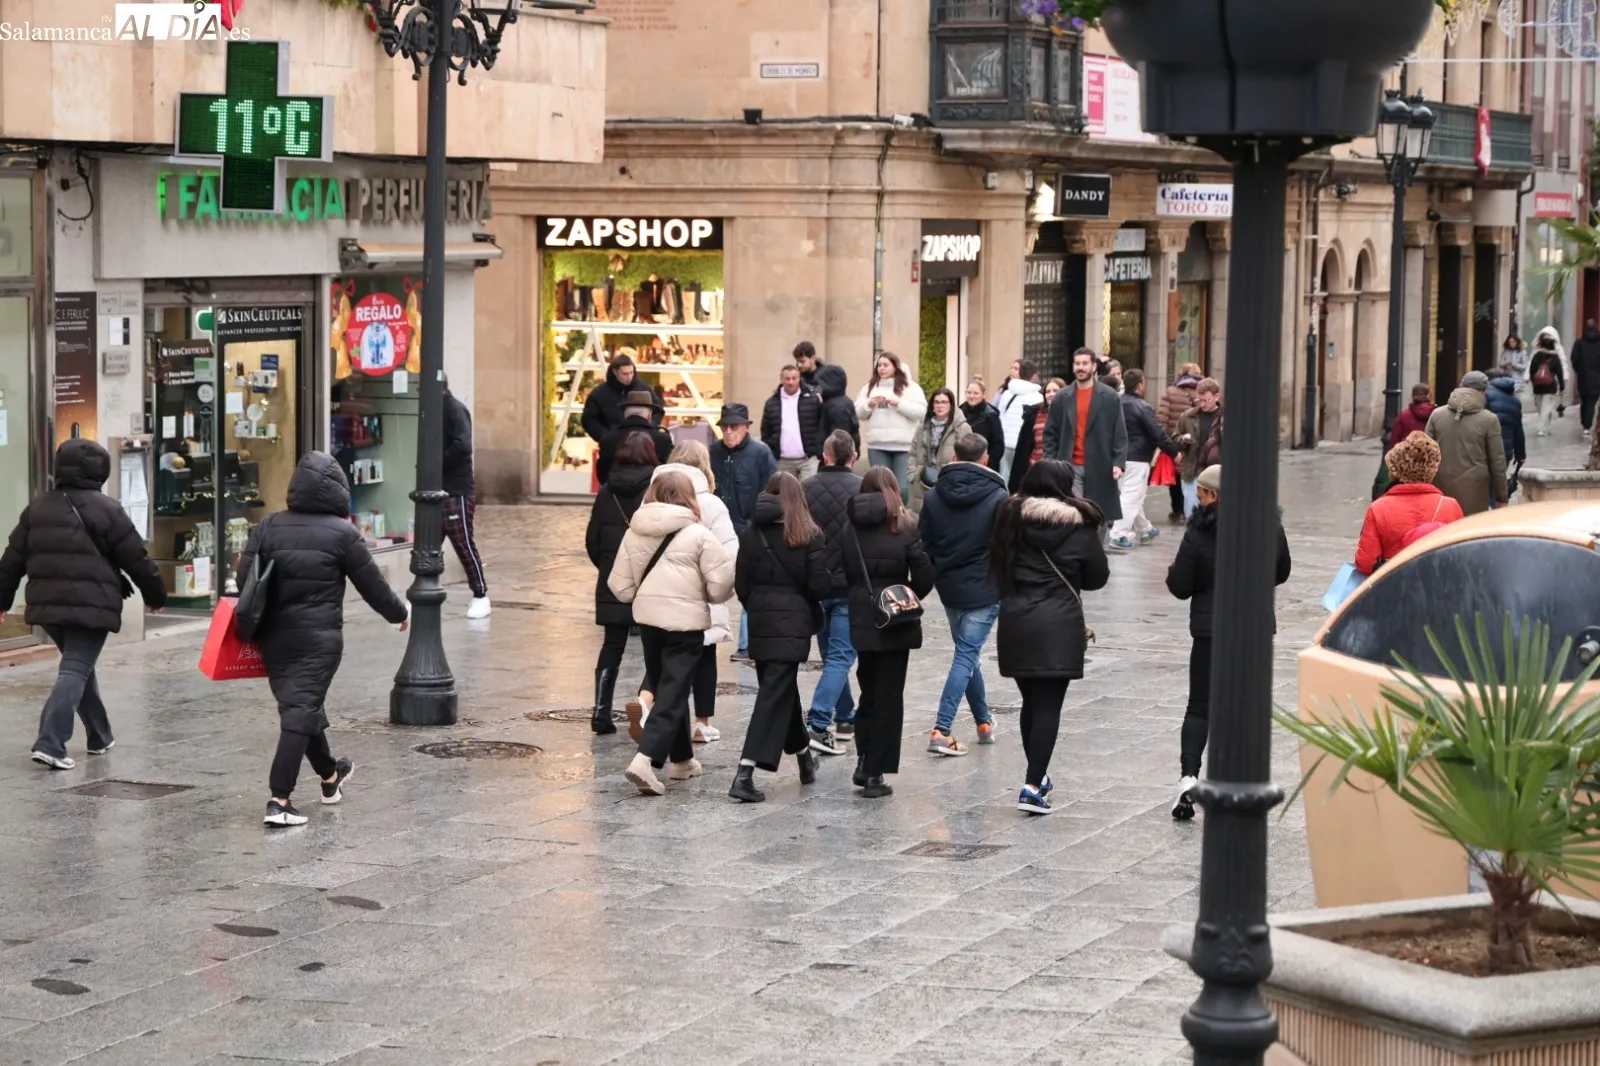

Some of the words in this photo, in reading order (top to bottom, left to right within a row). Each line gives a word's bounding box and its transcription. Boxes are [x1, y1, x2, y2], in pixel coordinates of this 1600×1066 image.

[179, 176, 345, 221] FACIA
[359, 177, 492, 221] PERFUERIA
[1065, 189, 1105, 201] DANDY
[1164, 201, 1208, 213] TORO
[1214, 204, 1229, 214] 70
[545, 218, 713, 248] ZAPSHOP
[922, 235, 981, 262] ZAPSHOP
[1024, 260, 1065, 285] DANDY
[1104, 256, 1152, 281] CAFETERIA
[356, 304, 402, 322] REGALO
